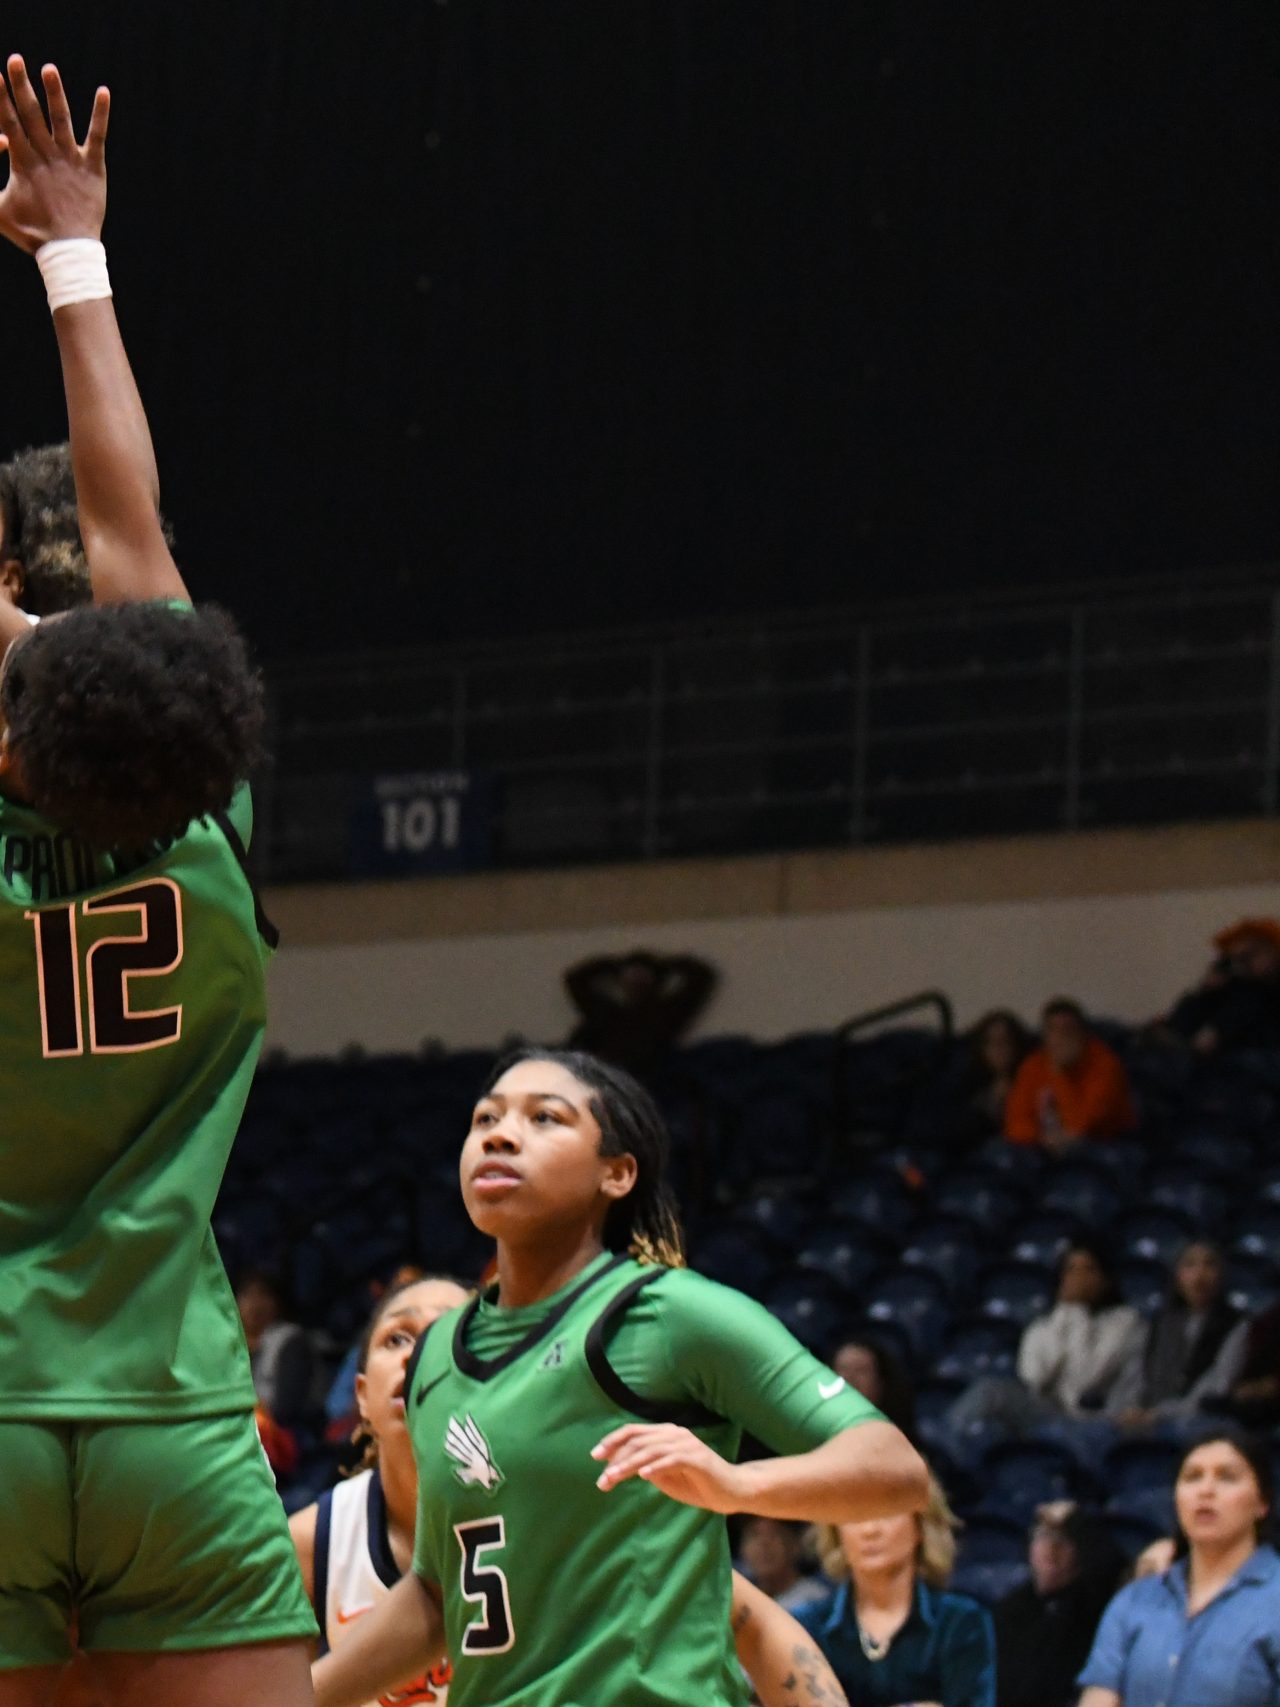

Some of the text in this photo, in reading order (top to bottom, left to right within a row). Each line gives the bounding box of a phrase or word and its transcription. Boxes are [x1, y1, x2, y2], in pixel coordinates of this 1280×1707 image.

[382, 798, 461, 852] 101
[24, 876, 184, 1059] 12
[453, 1514, 516, 1656] 5
